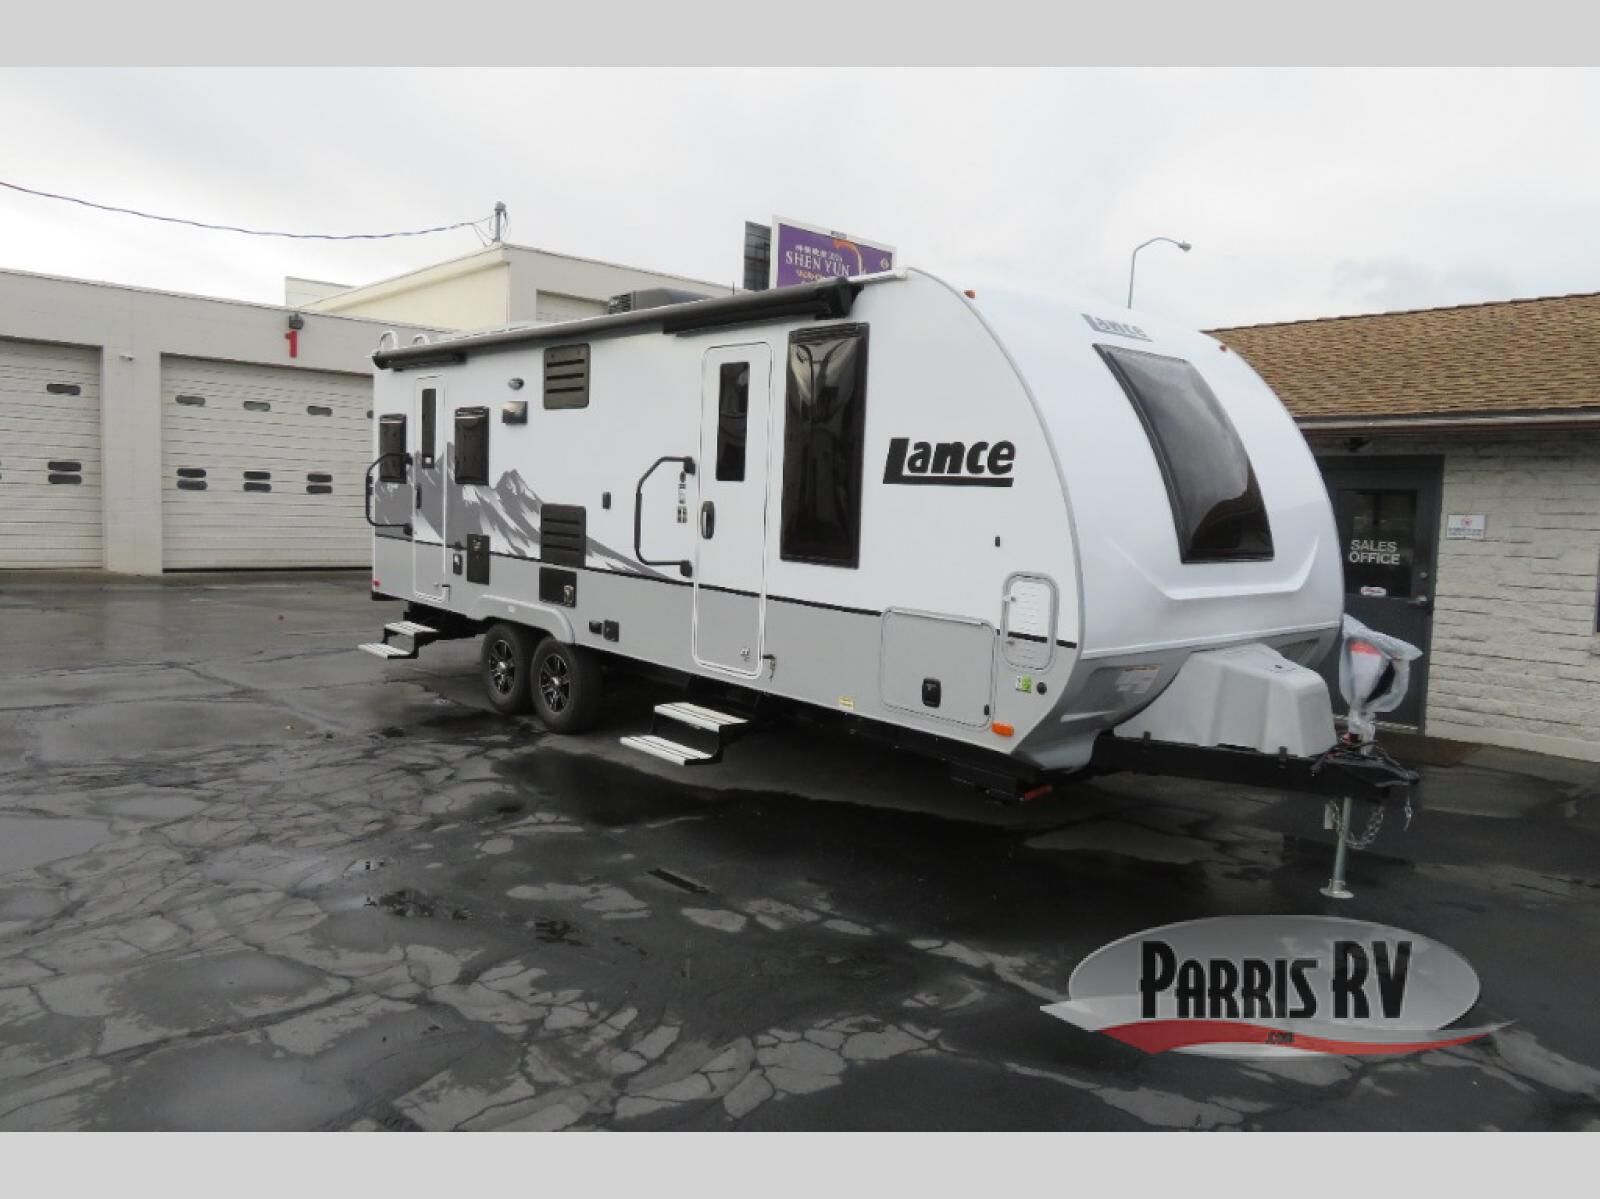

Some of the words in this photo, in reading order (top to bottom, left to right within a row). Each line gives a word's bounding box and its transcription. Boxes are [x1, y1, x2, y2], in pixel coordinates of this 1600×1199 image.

[785, 250, 821, 270] SHEN
[825, 260, 851, 277] YUN
[285, 330, 298, 358] 1
[883, 437, 1016, 487] Lance
[1348, 551, 1401, 565] OFFICE
[1350, 539, 1398, 552] SALES
